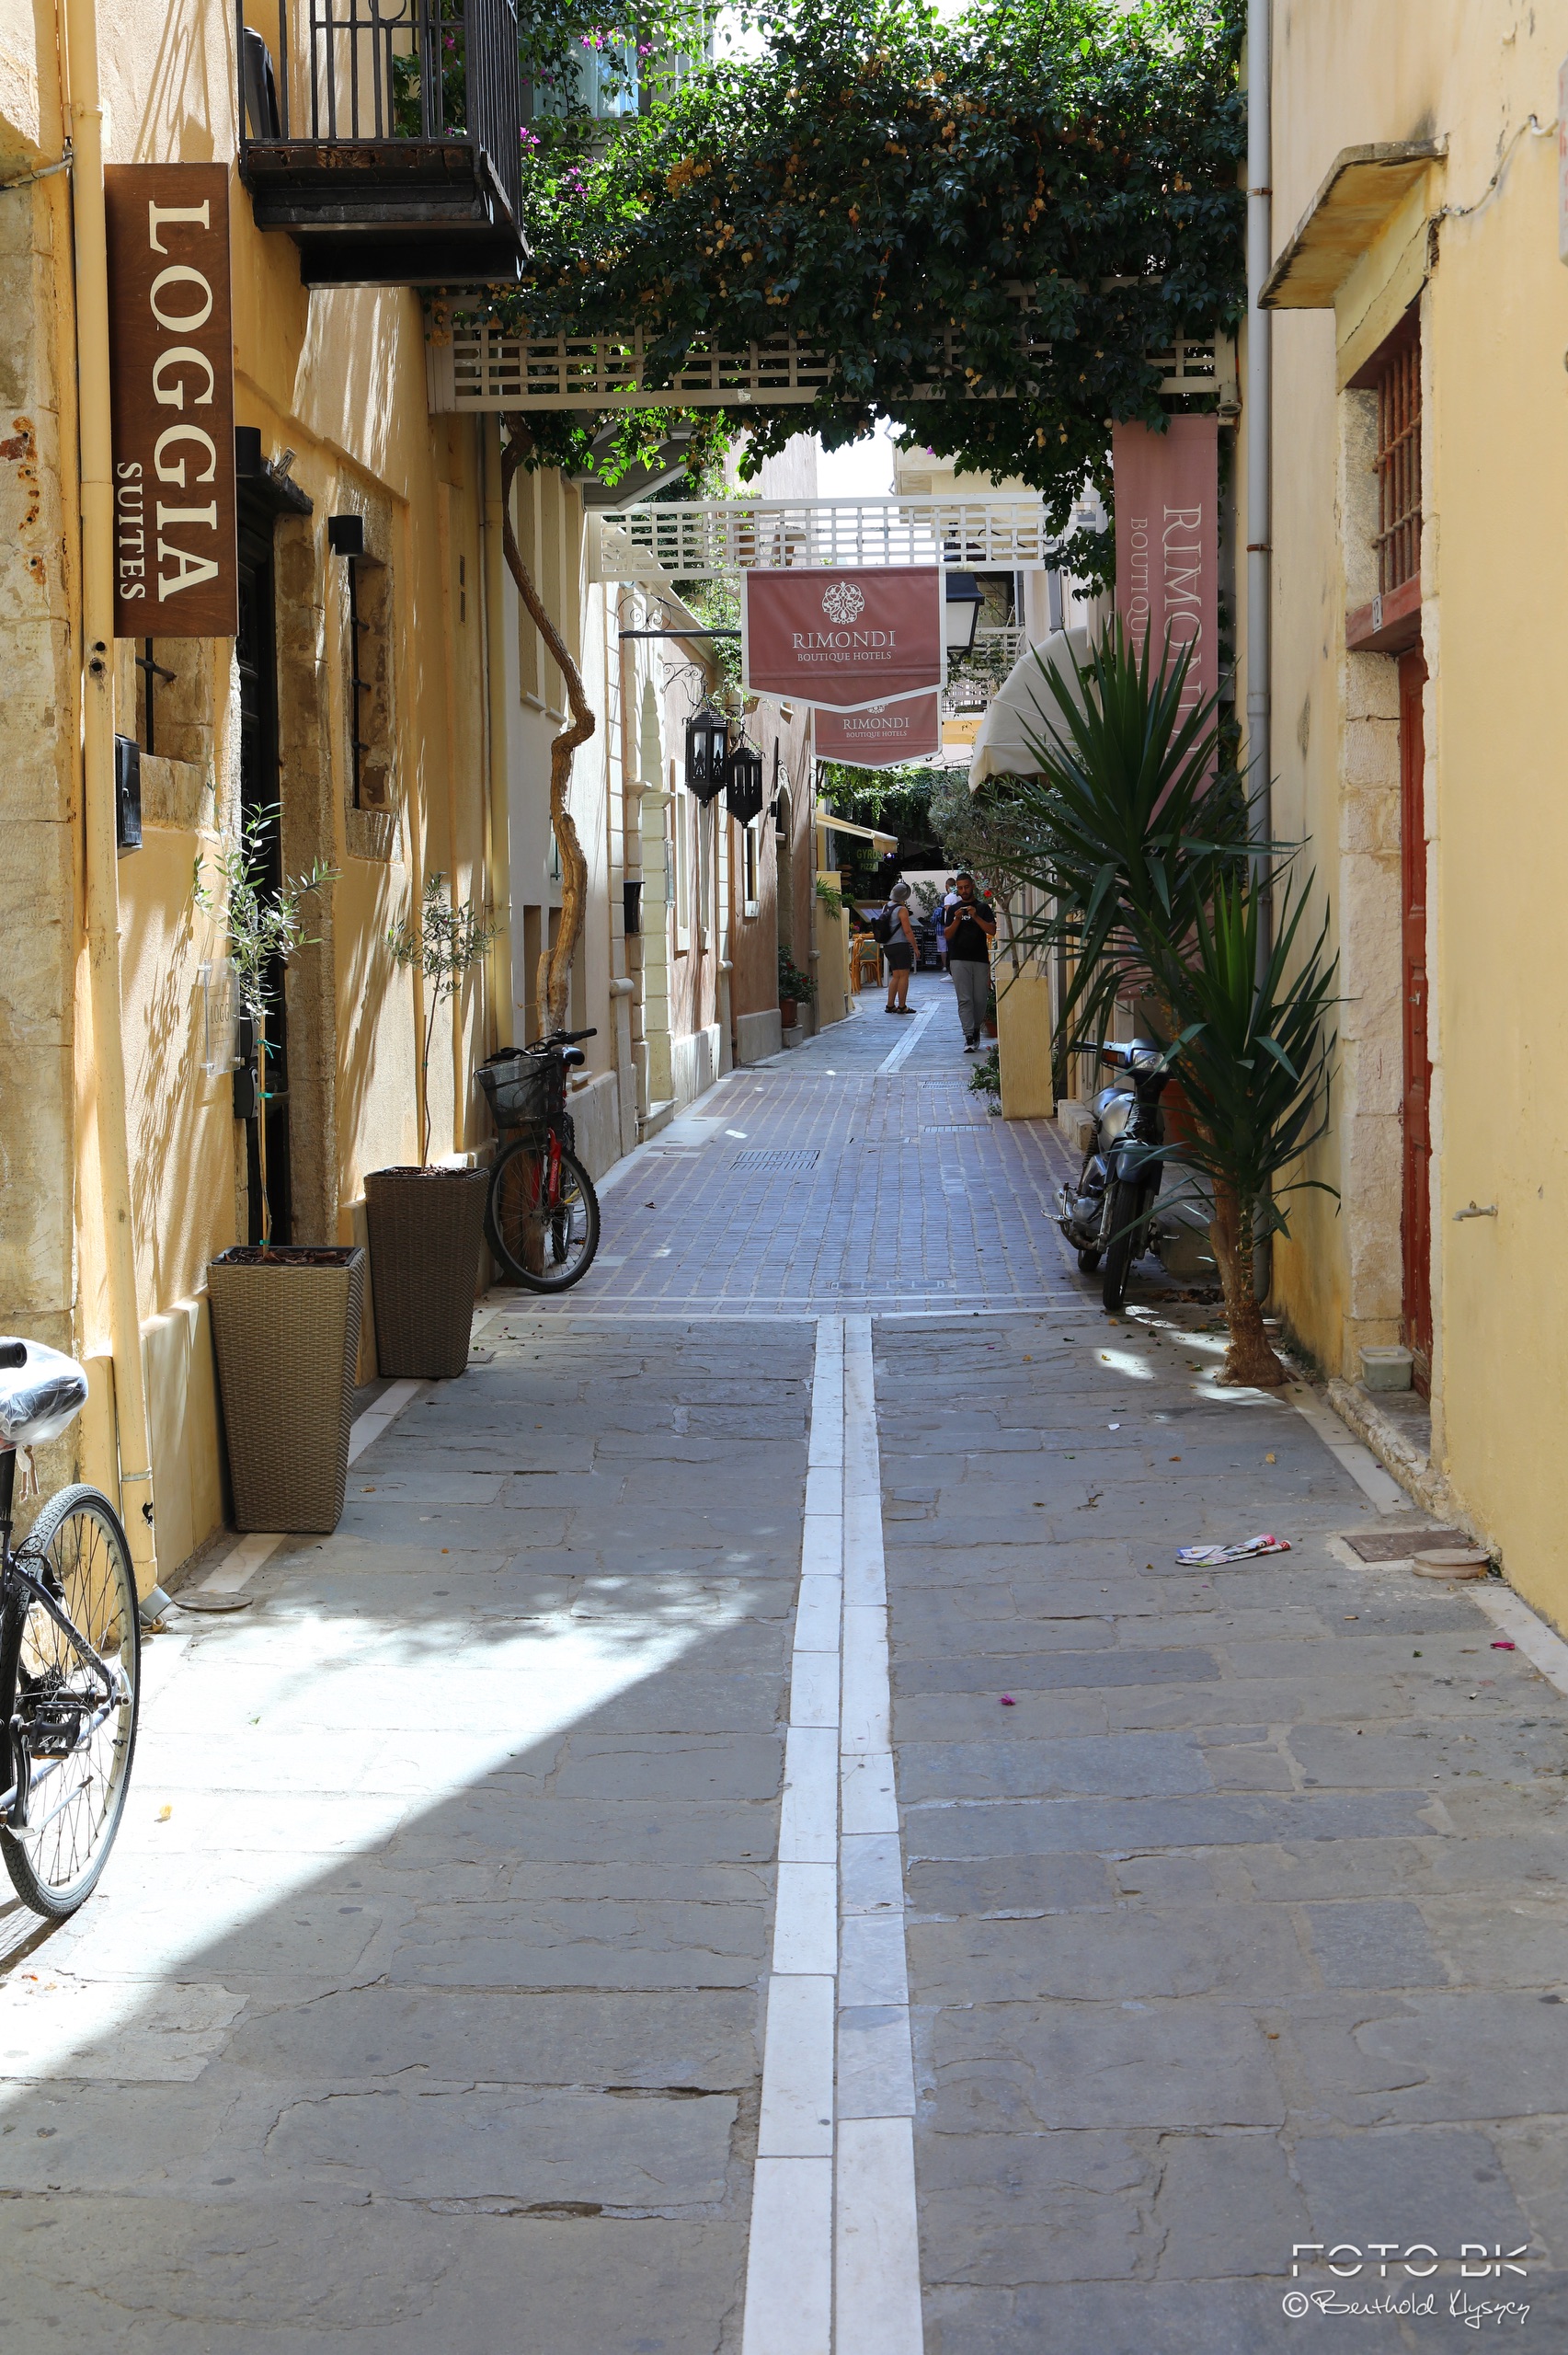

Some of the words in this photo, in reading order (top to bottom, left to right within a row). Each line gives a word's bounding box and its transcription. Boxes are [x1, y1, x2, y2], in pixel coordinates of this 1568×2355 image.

[148, 199, 220, 603] LOGGIA
[117, 462, 146, 601] SUITES
[792, 630, 897, 649] RIMONDI
[797, 652, 851, 663] BOUTIQUE
[853, 650, 892, 661] HOTELS
[842, 717, 910, 730] RIMONDI
[846, 730, 880, 739] BOUTIQUE
[856, 848, 883, 859] GYROS
